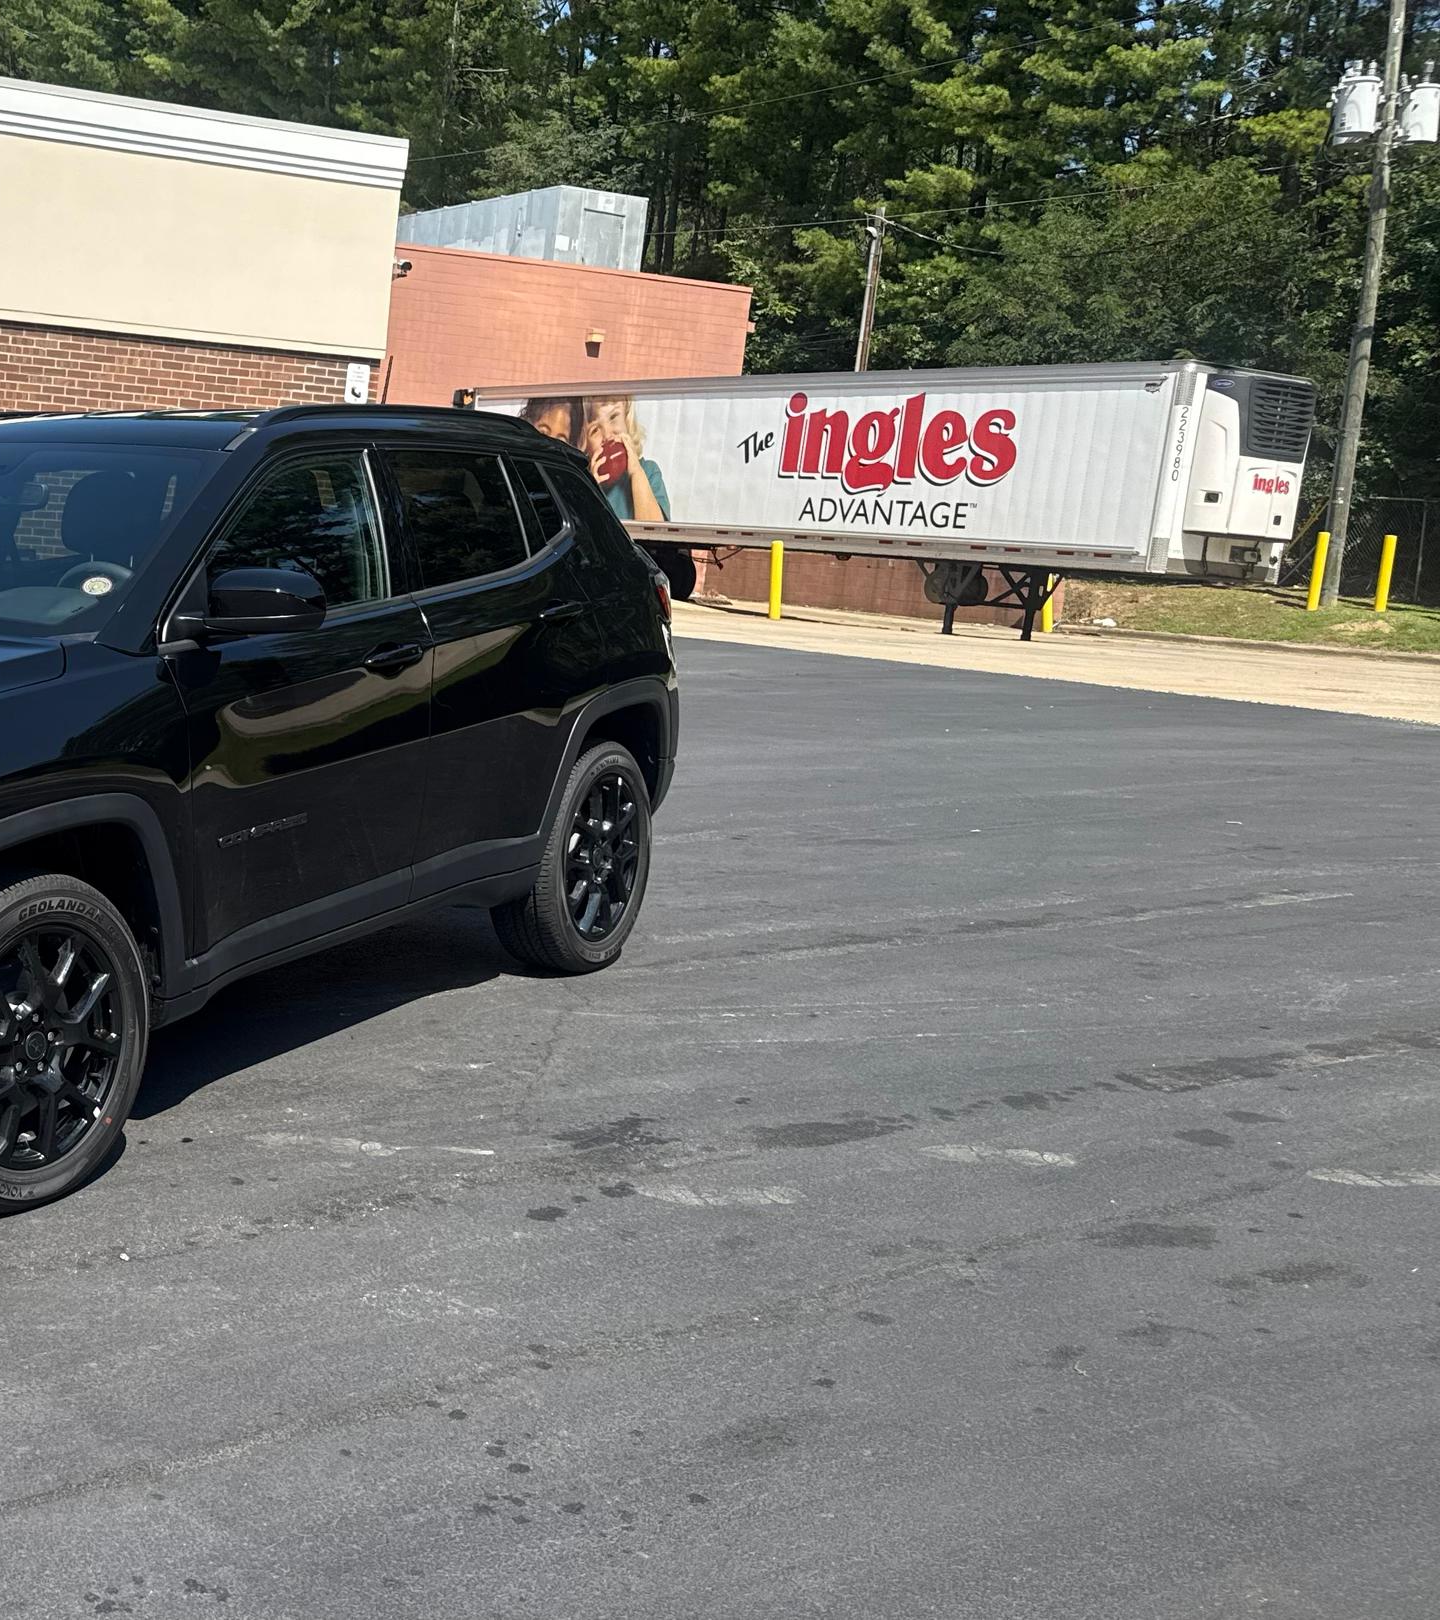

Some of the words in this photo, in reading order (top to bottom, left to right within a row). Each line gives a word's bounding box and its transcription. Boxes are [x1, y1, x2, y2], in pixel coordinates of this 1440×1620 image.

[737, 431, 775, 464] The
[778, 391, 1018, 498] ingles
[1171, 406, 1190, 482] 223980
[1252, 473, 1290, 495] ingles
